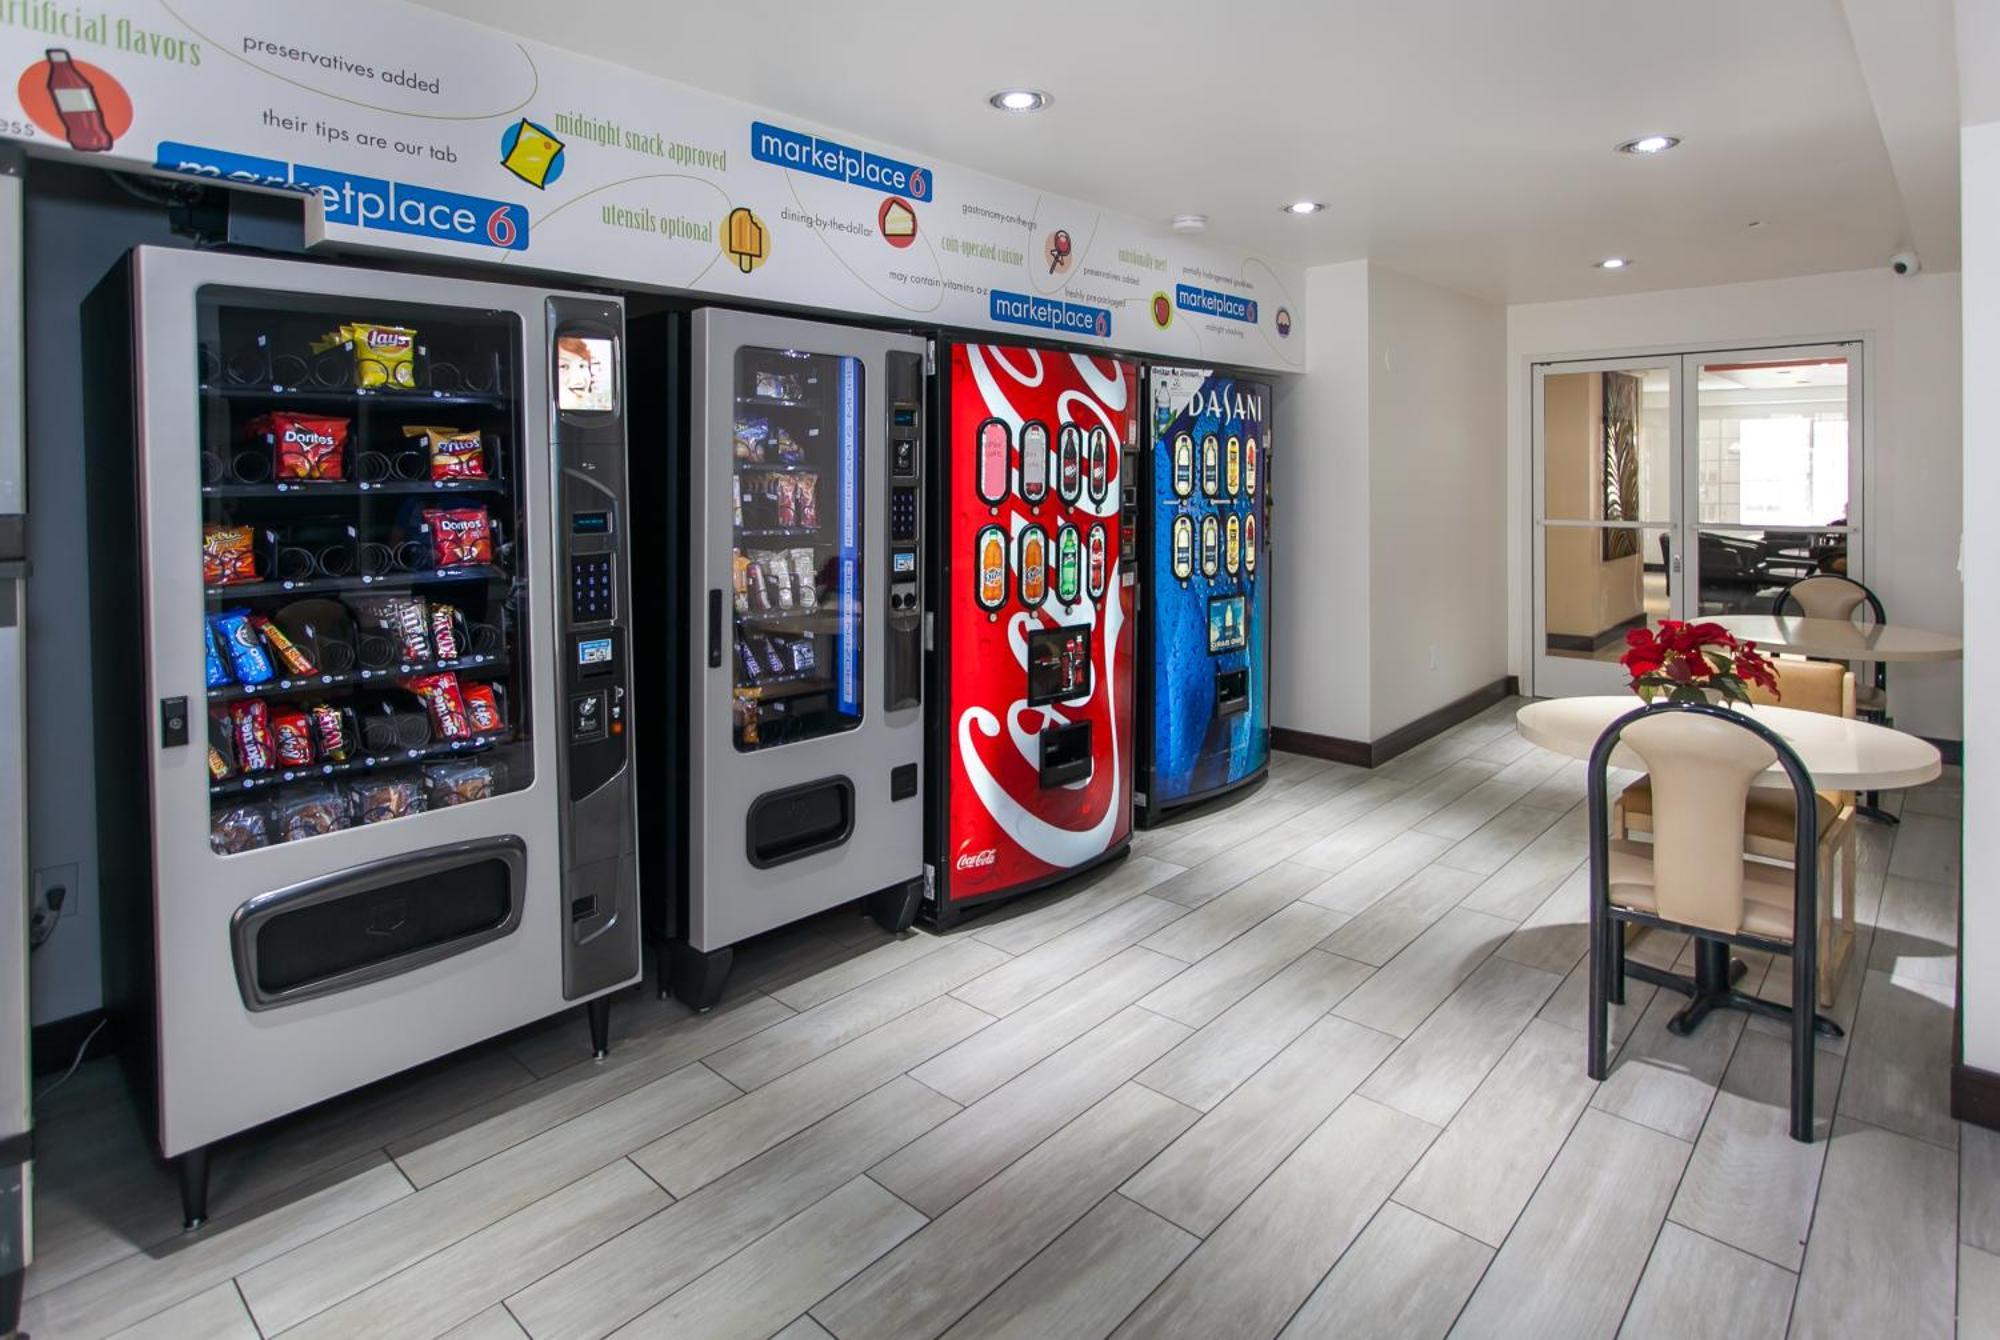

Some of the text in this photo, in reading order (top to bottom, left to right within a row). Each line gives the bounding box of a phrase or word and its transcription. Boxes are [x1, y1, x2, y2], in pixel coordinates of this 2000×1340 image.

[0, 0, 202, 67] rtificial flavors
[243, 36, 440, 95] preservatives added
[263, 108, 457, 164] their tips are our tab
[555, 111, 727, 172] midnight snack approved
[761, 134, 926, 198] marketplace 6
[486, 206, 518, 248] 6
[601, 204, 712, 243] utensils optional
[781, 207, 873, 237] dining-by-the-dollar
[889, 270, 908, 285] may
[910, 273, 941, 288] contain
[943, 279, 975, 295] vitamins
[1180, 288, 1246, 317] marketplace
[996, 295, 1108, 337] marketplace 6
[1189, 383, 1262, 426] DASANI
[285, 430, 334, 445] Doritos
[441, 520, 482, 531] Doritos
[957, 849, 997, 870] Coca-Cola
